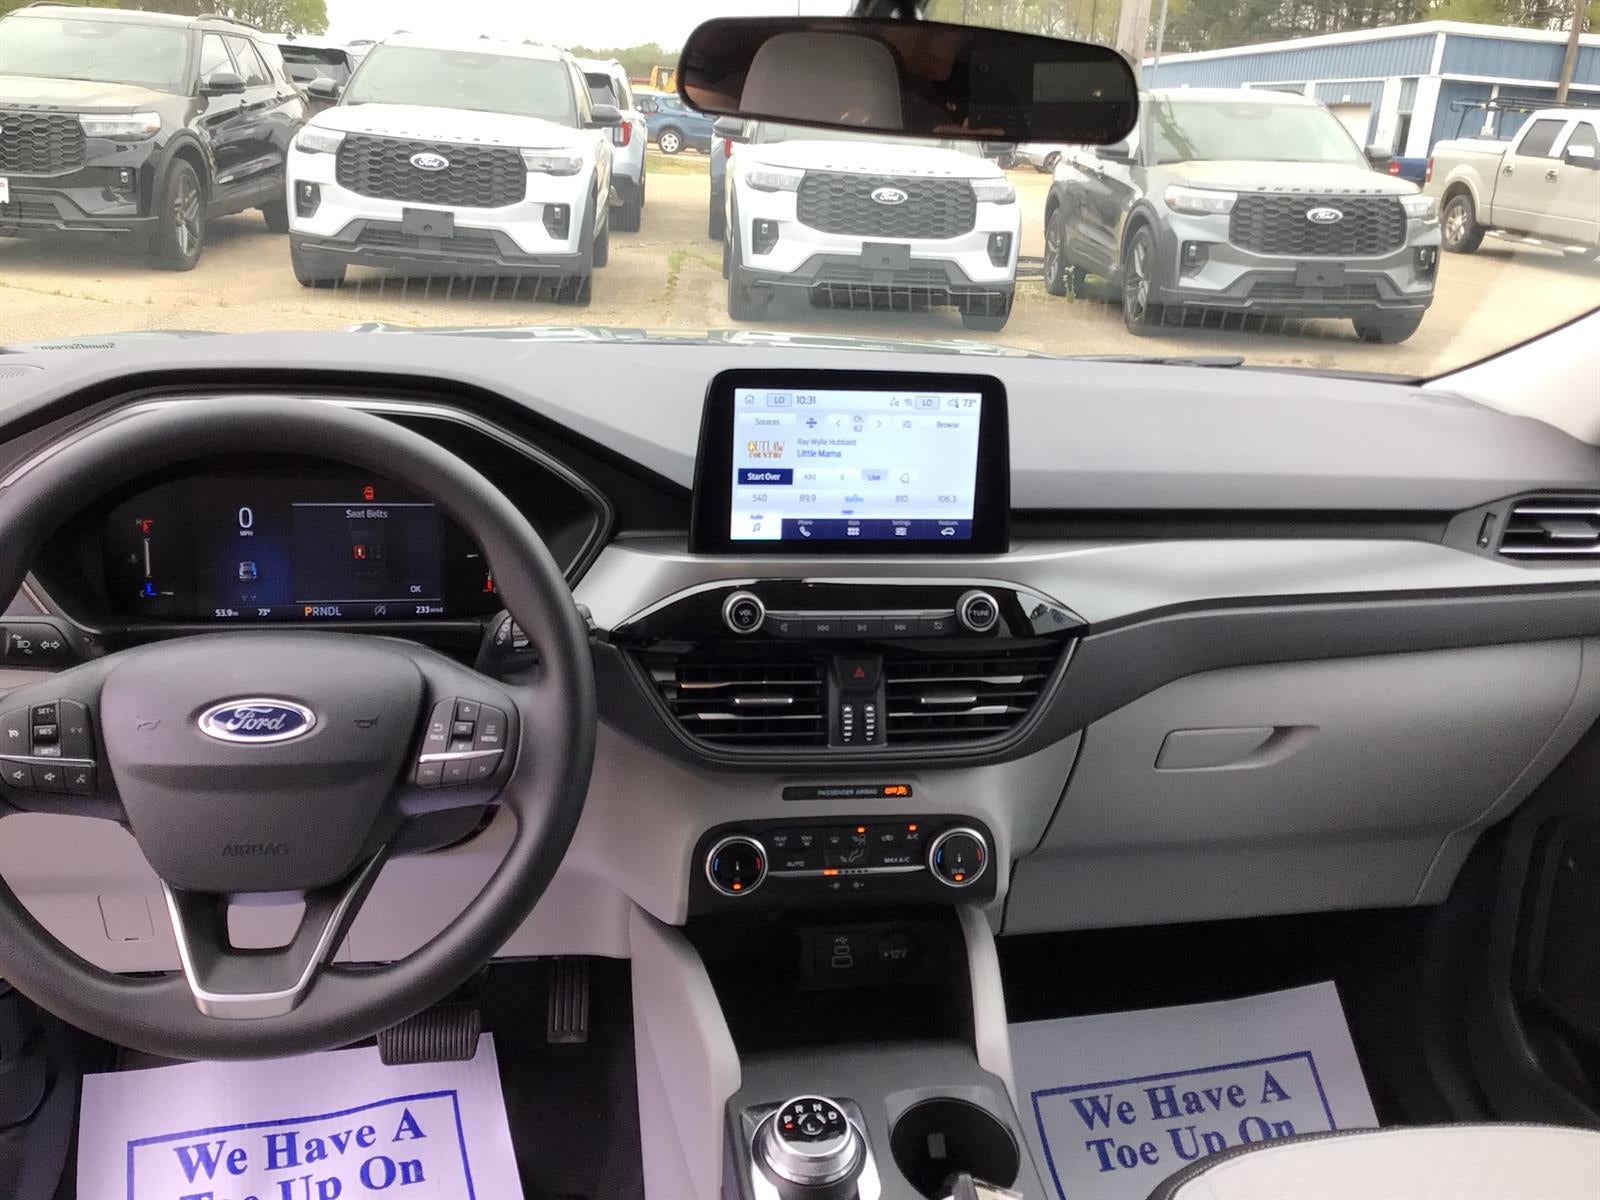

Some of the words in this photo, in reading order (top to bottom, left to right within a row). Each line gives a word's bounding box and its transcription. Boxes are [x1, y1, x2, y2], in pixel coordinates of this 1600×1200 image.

[795, 395, 817, 405] 10:31
[754, 417, 780, 426] Sources
[936, 420, 960, 429] Browse
[747, 440, 785, 452] OUTLAW
[829, 438, 857, 447] Hubbard
[797, 449, 818, 458] Little
[818, 450, 842, 458] Mama
[746, 472, 765, 481] Start
[765, 472, 782, 481] Over
[751, 493, 768, 503] 540
[799, 494, 817, 503] 89.9
[345, 509, 366, 519] Seat
[366, 509, 389, 519] Belts
[410, 585, 422, 593] OK
[304, 606, 342, 617] PRNDL
[971, 609, 990, 617] TUNE
[226, 707, 286, 731] Ford
[817, 788, 854, 796] PASSENGER
[855, 788, 879, 796] AIRBAG
[221, 843, 289, 857] AIRBAG
[786, 860, 806, 868] AUTO
[1068, 1093, 1137, 1132] We
[1144, 1084, 1247, 1121] Have
[1259, 1069, 1292, 1104] A
[795, 1105, 803, 1113] R
[812, 1104, 822, 1112] N
[828, 1111, 837, 1120] D
[807, 1123, 815, 1131] L
[172, 1140, 249, 1184] We
[263, 1124, 377, 1172] Have
[391, 1107, 428, 1141] A
[1085, 1137, 1160, 1173] Toe
[1166, 1125, 1227, 1161] Up
[1237, 1116, 1296, 1148] On
[358, 1154, 428, 1191] On
